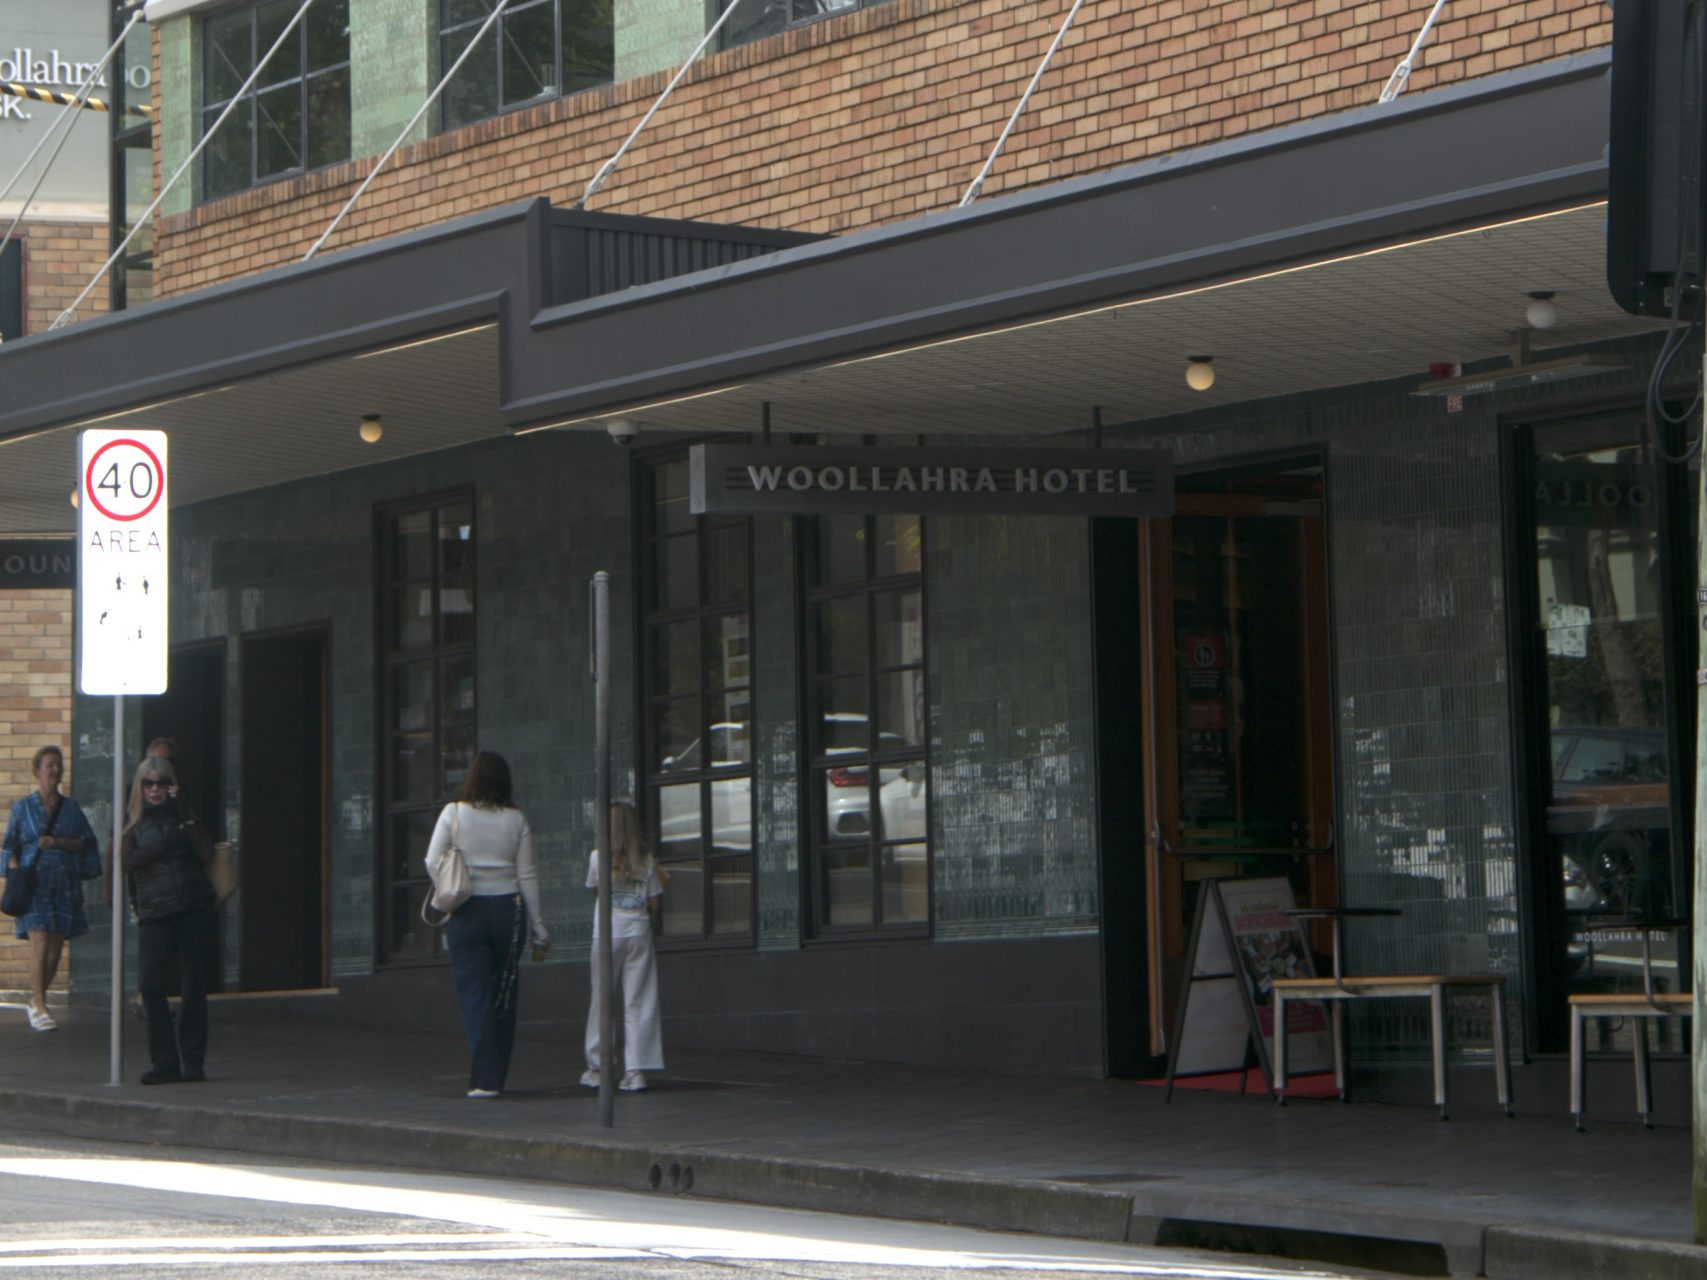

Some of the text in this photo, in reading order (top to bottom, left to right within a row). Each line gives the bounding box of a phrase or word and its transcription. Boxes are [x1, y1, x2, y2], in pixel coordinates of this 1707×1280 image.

[97, 462, 153, 498] 40
[746, 464, 1138, 494] WOOLLAHRA HOTEL
[89, 529, 162, 553] AREA
[1636, 930, 1666, 942] HTEL
